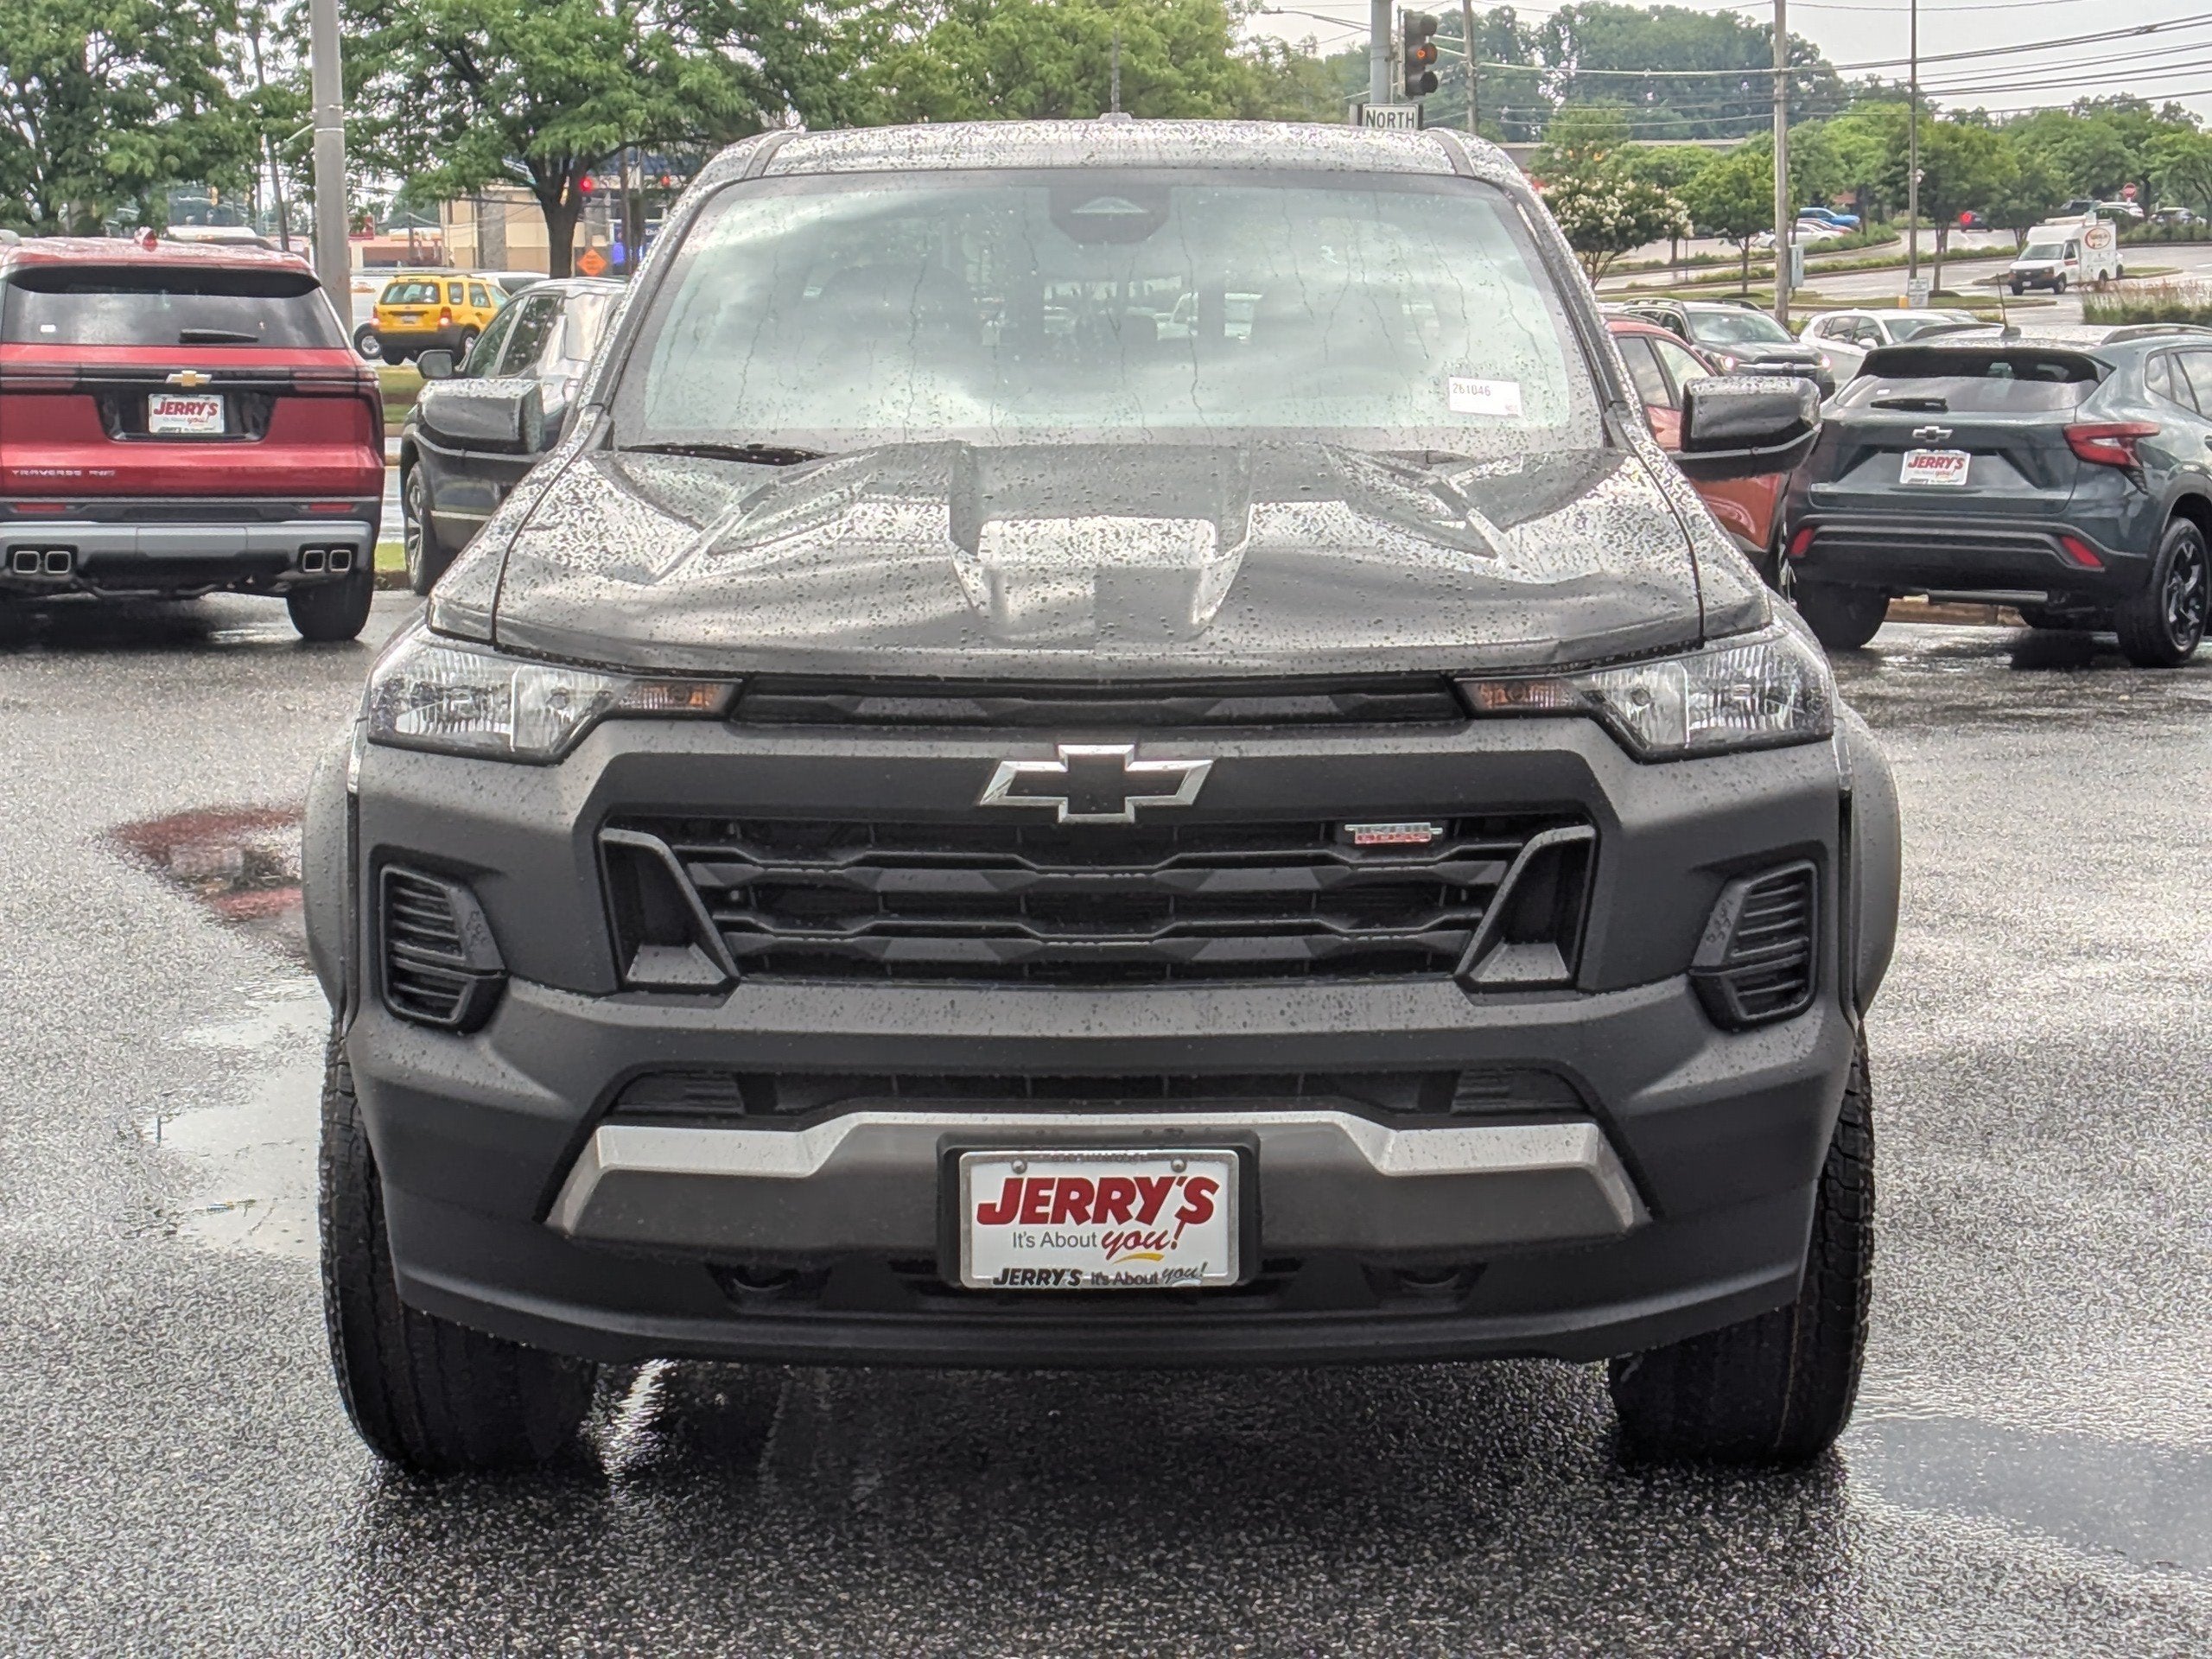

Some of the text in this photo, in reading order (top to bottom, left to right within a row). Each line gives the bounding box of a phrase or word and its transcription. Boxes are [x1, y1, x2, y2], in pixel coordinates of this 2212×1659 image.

[1366, 110, 1414, 129] NORTH
[154, 401, 219, 416] JERRY'S
[1908, 456, 1965, 469] JERRY'S
[976, 1176, 1220, 1226] JERRY'S
[1013, 1220, 1186, 1261] It's About you!
[993, 1262, 1208, 1287] JERRY'S It's About you!
